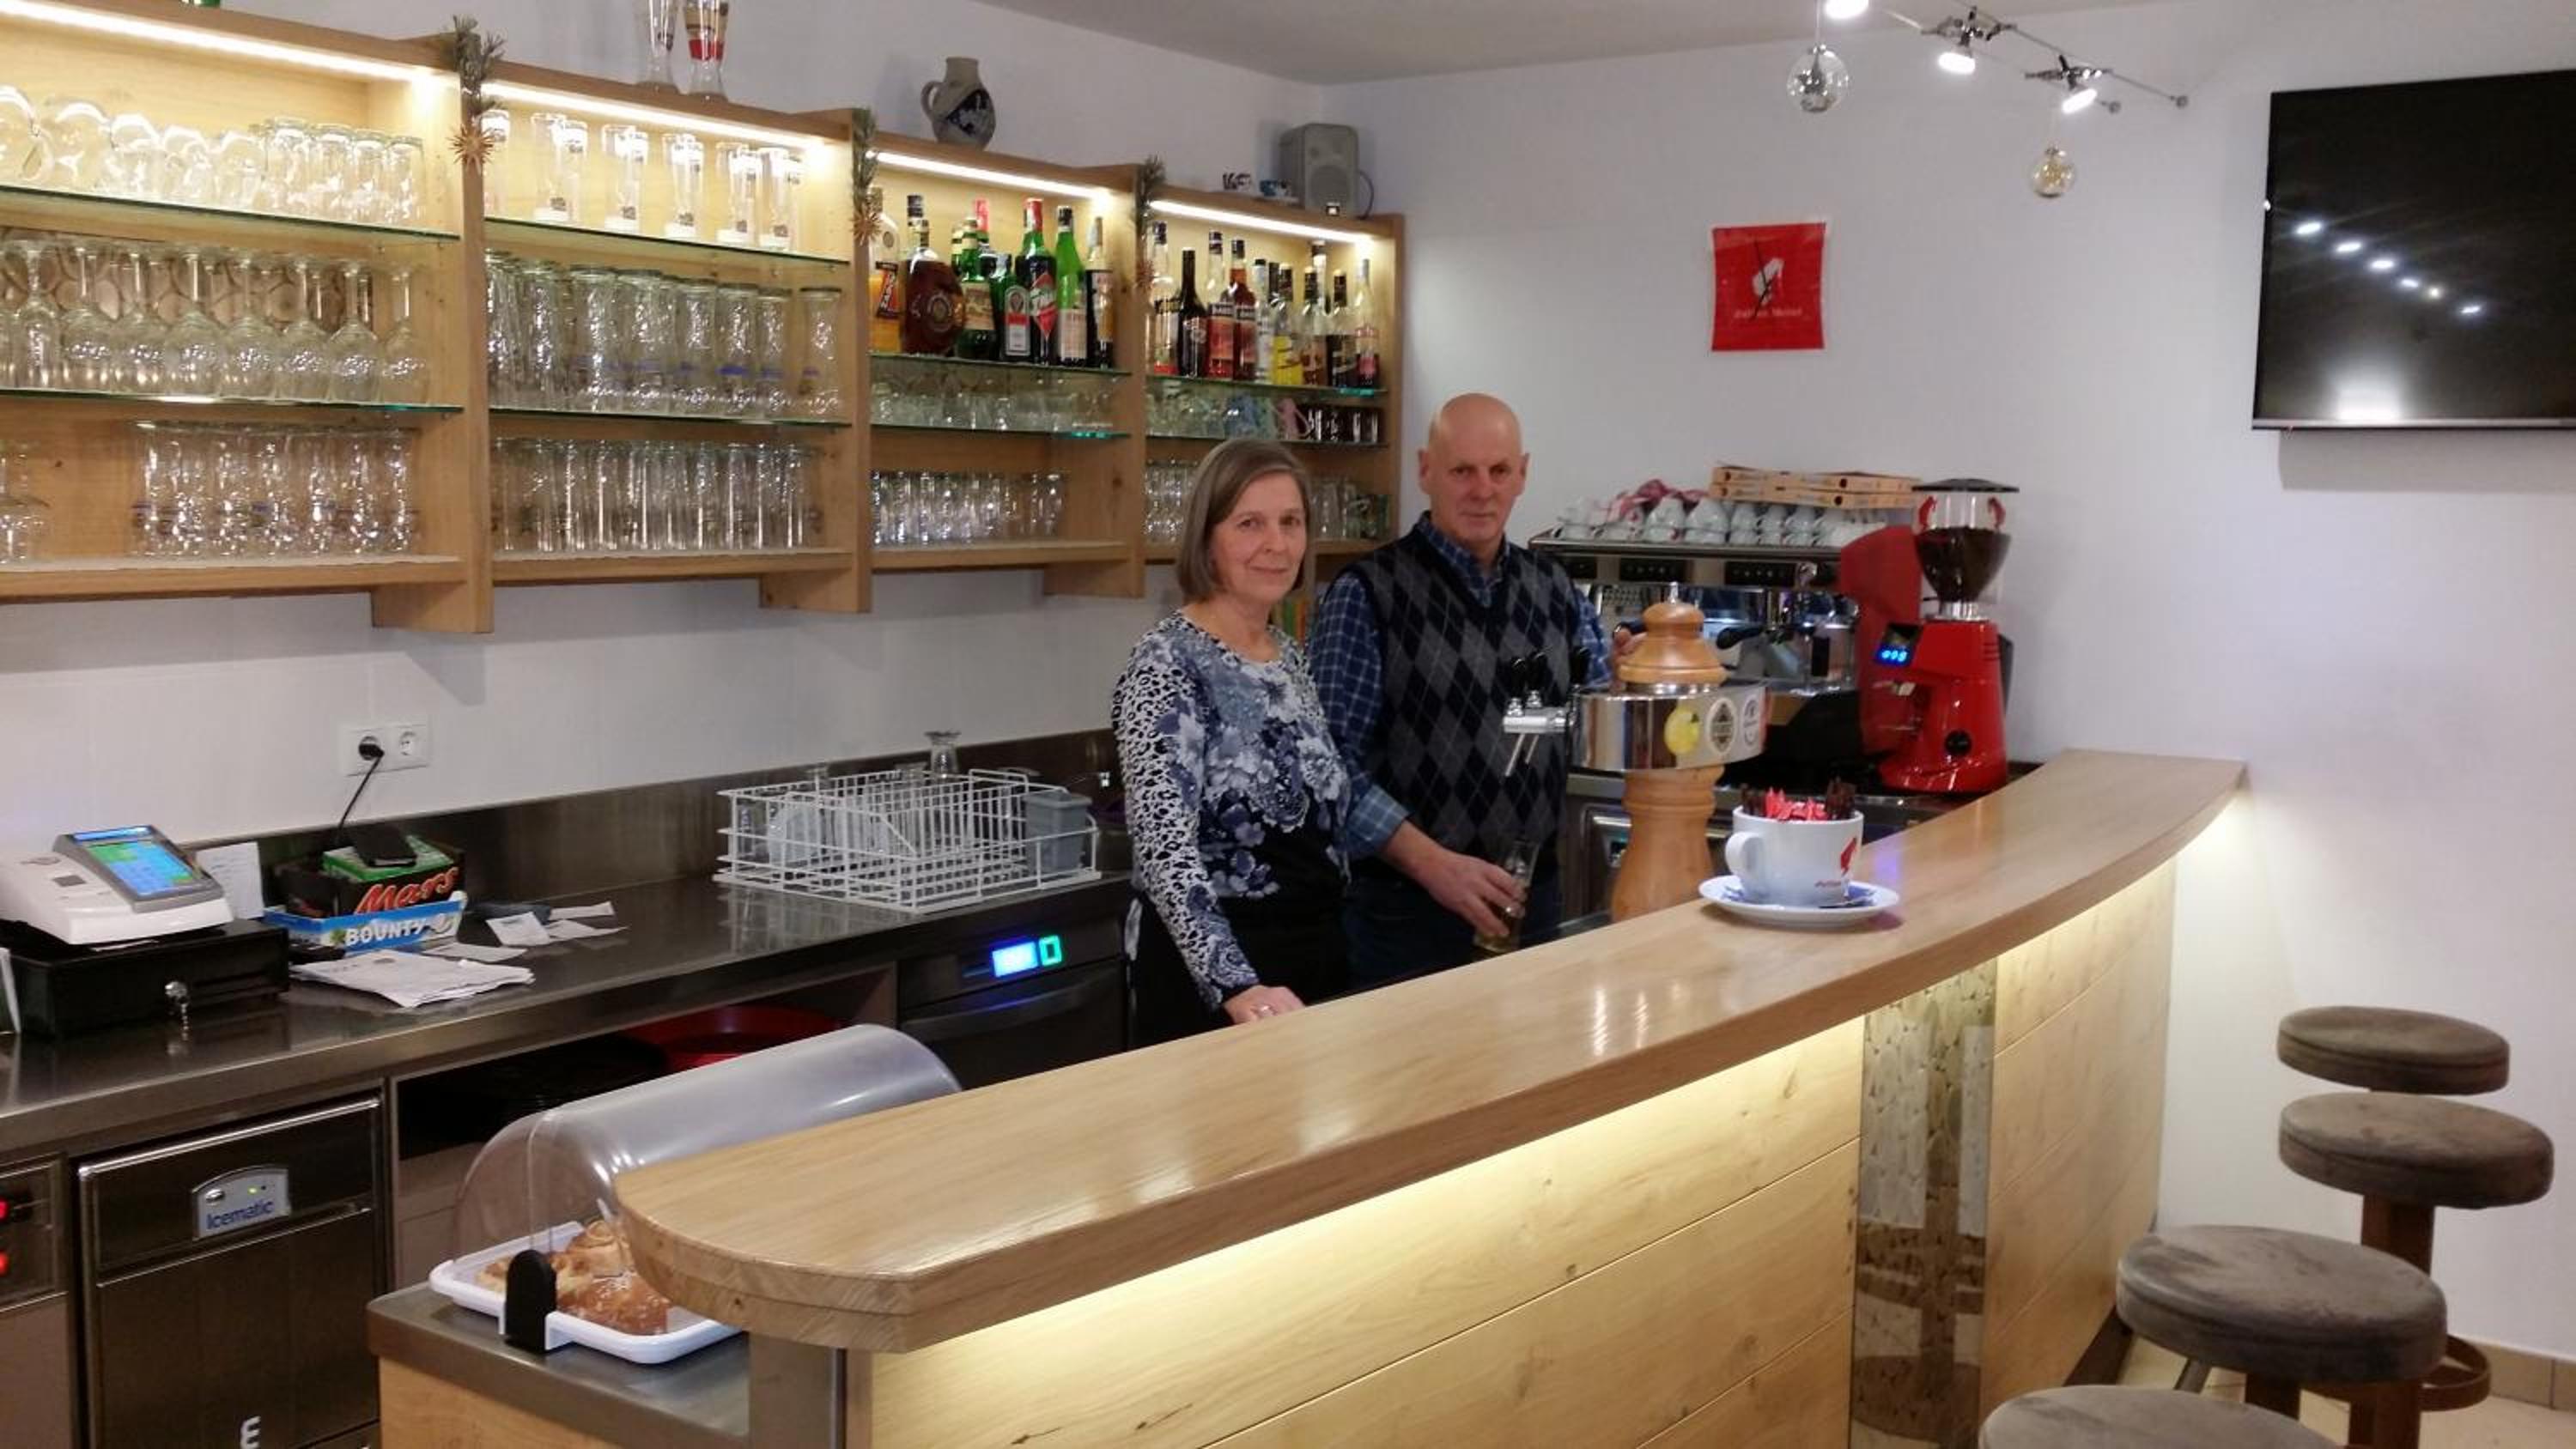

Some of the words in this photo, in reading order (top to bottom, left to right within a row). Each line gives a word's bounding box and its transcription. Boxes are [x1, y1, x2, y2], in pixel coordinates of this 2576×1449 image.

[354, 866, 459, 915] Mars
[344, 918, 428, 945] BOUNTY
[206, 1200, 274, 1229] Icematic
